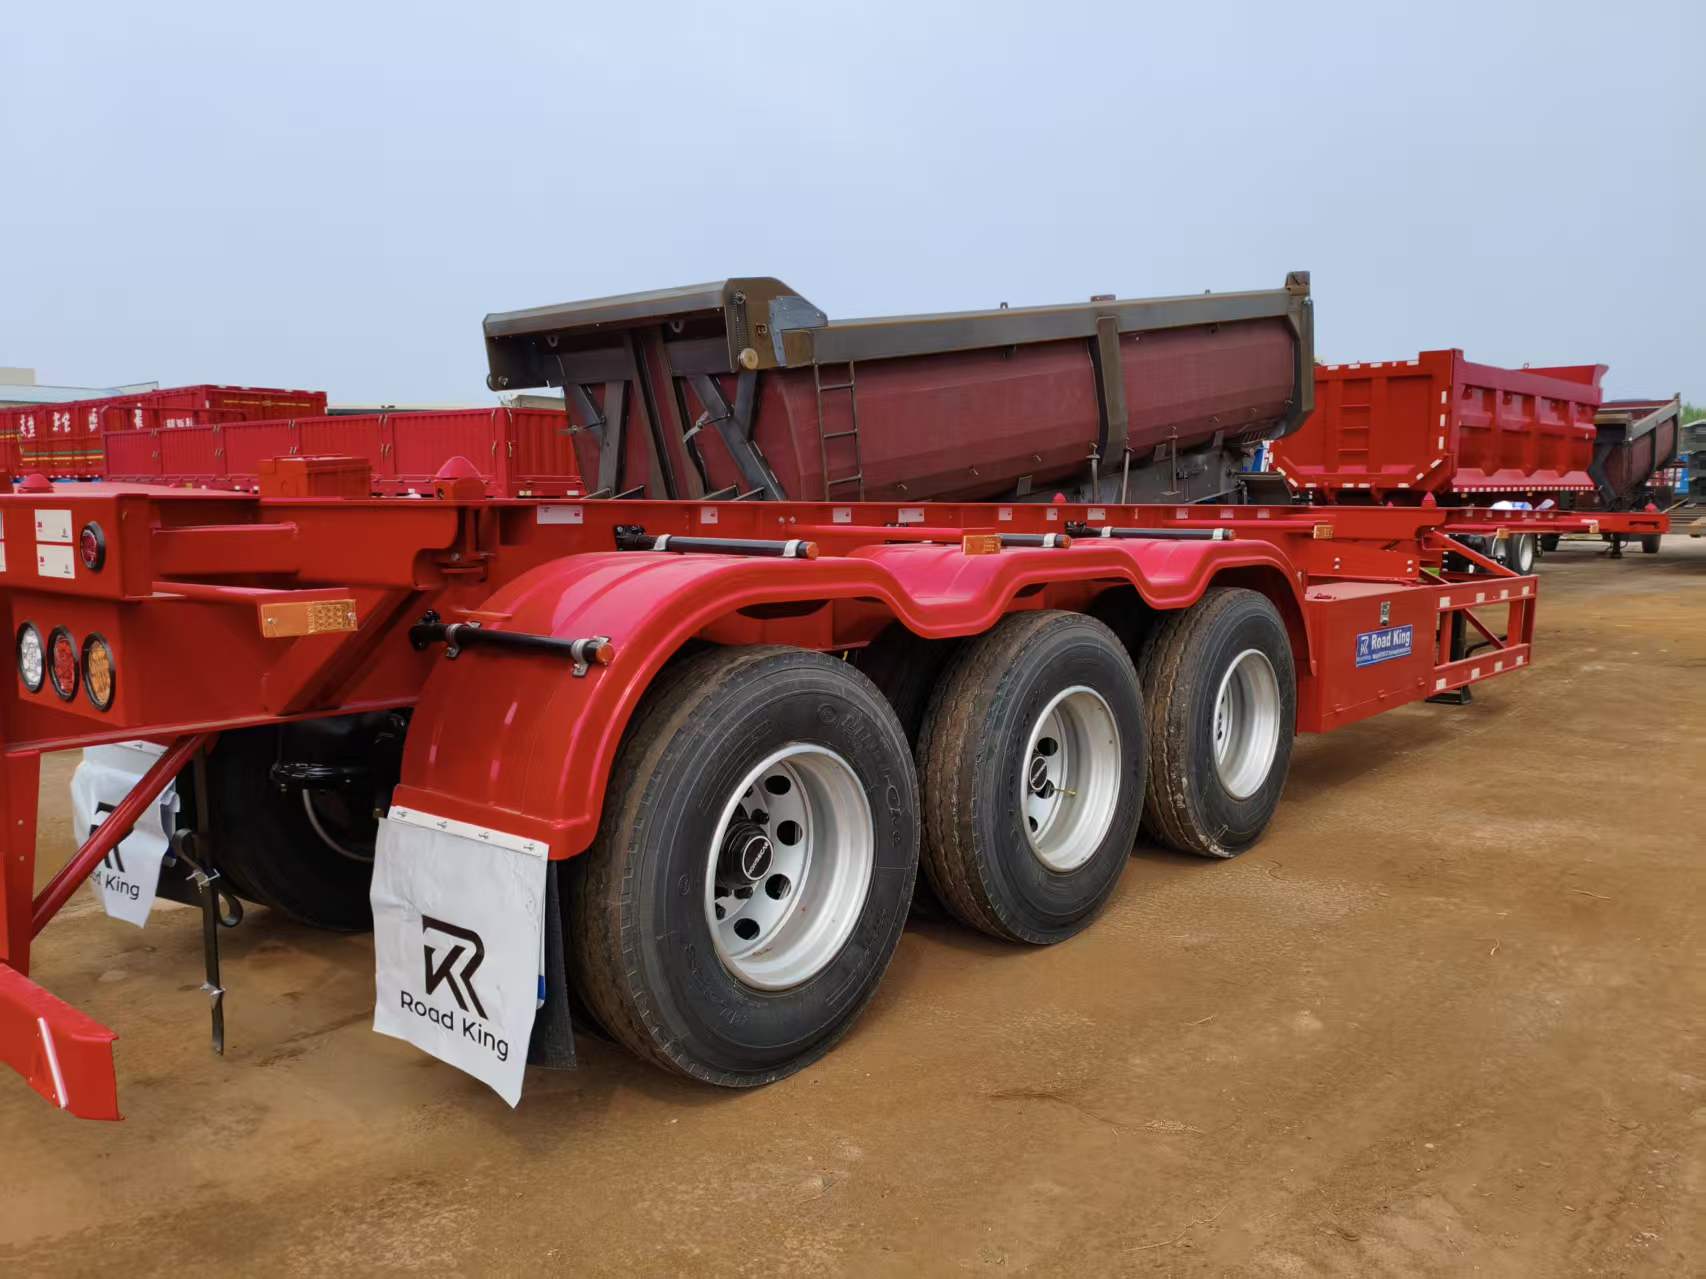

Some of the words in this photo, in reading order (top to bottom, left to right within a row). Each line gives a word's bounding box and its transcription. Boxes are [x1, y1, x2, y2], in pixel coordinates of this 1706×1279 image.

[1371, 632, 1391, 650] Road
[1393, 629, 1411, 646] King
[105, 874, 140, 900] King
[401, 990, 455, 1031] Road
[463, 1017, 509, 1062] King
